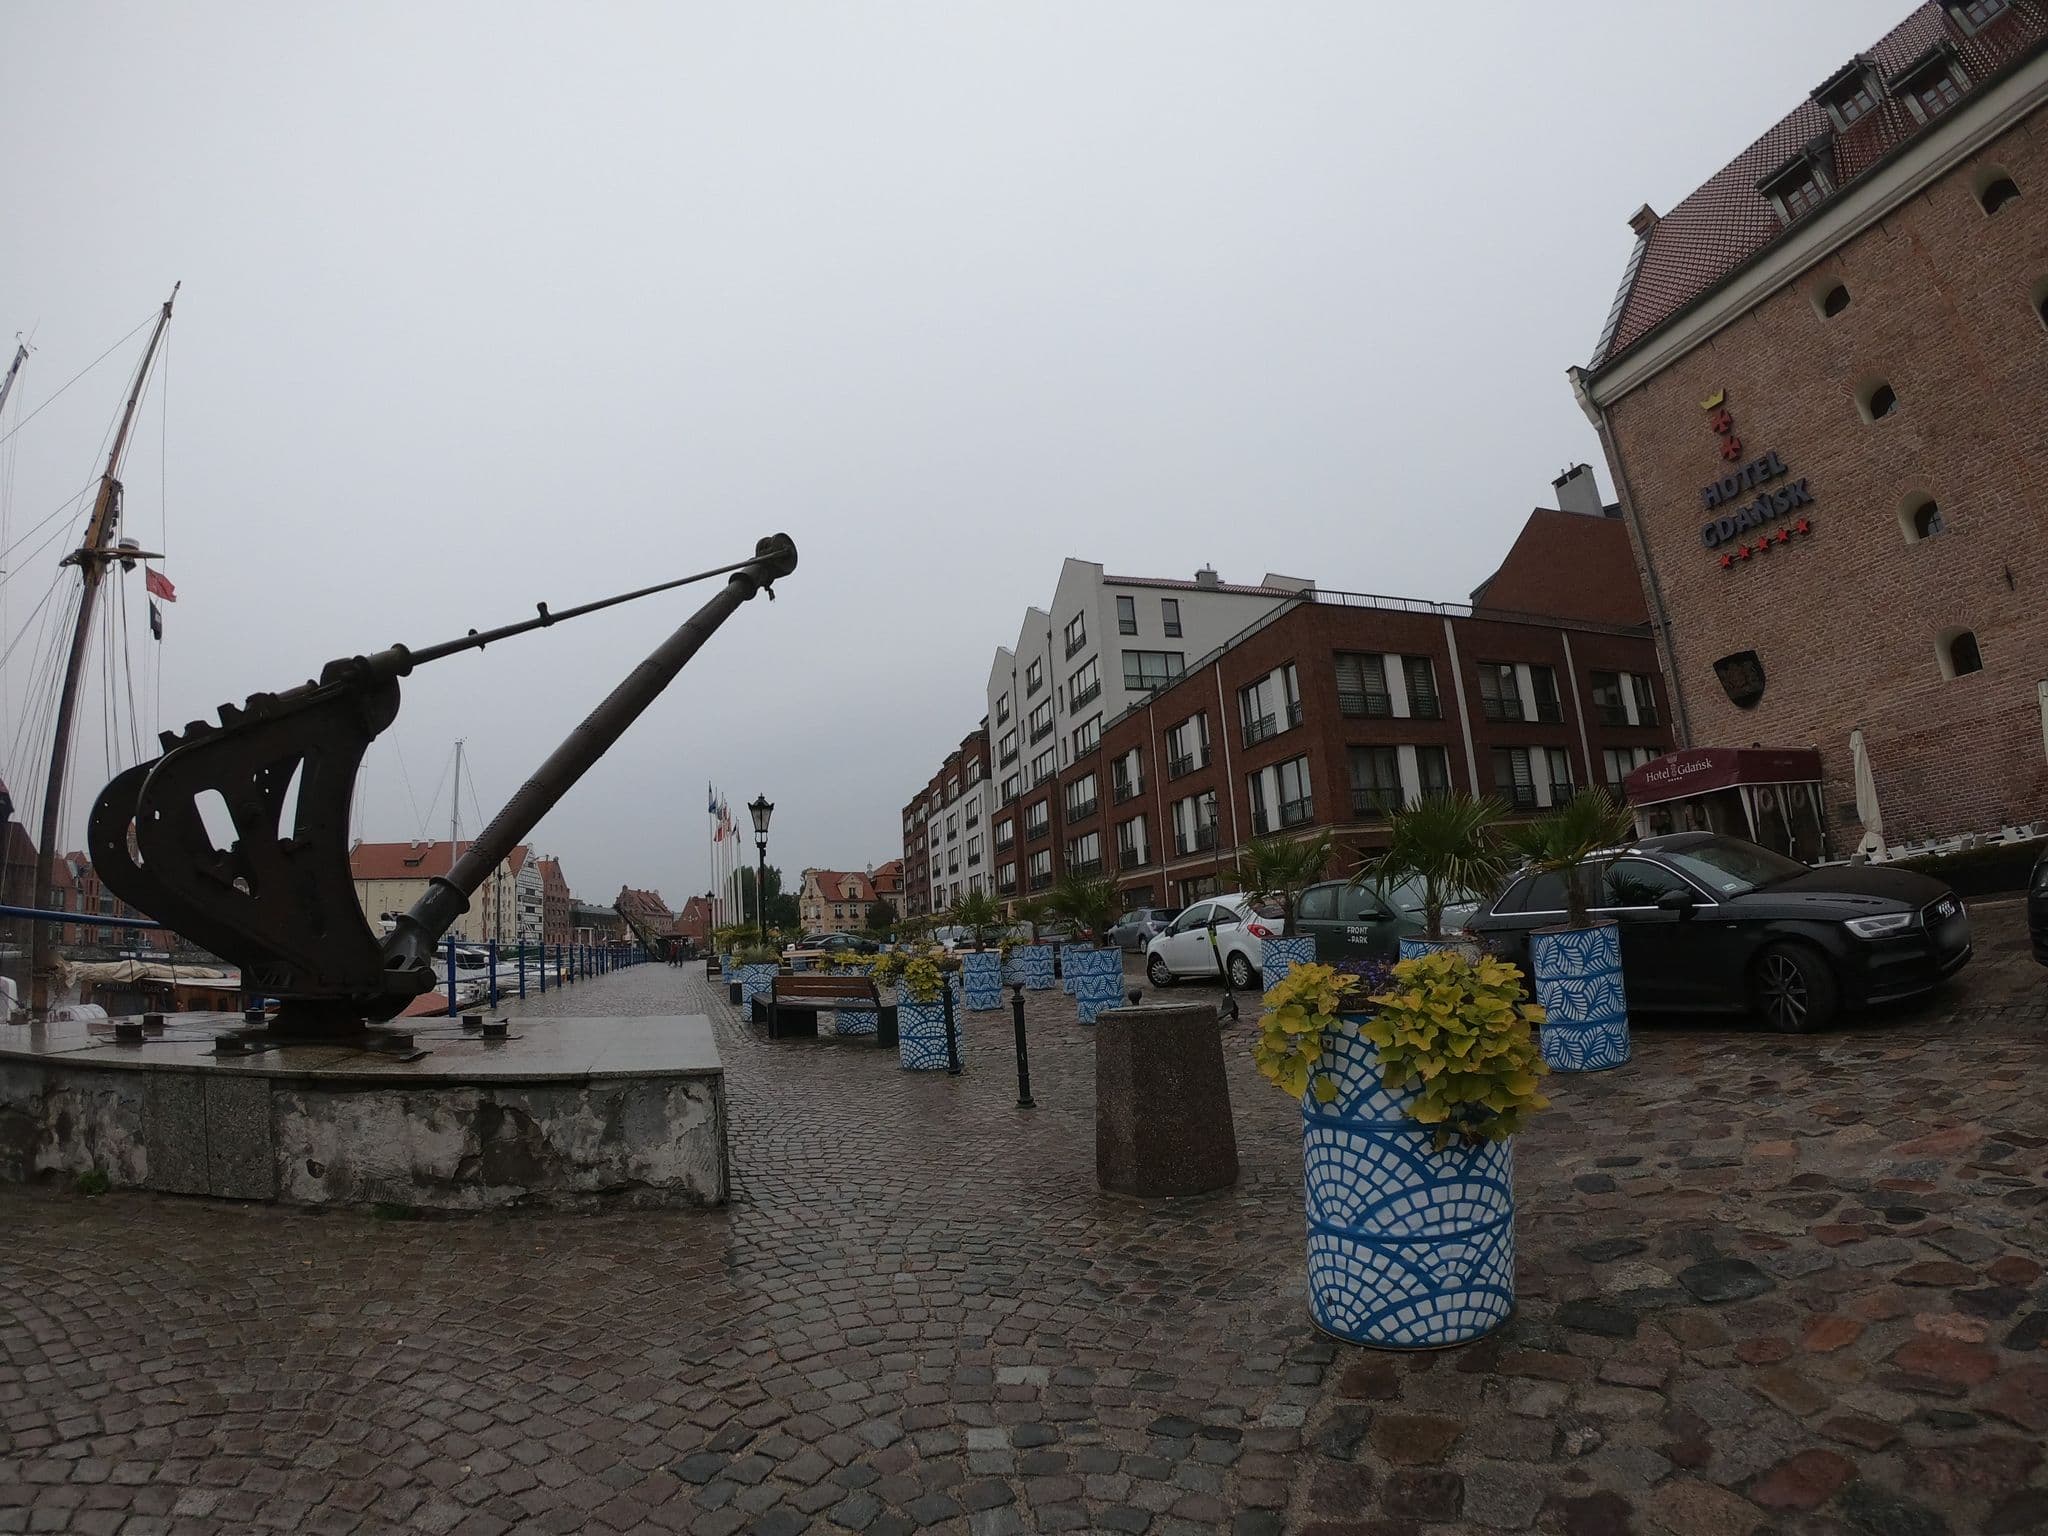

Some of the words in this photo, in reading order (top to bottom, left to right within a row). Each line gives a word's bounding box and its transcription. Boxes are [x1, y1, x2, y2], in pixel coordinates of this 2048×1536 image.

[1701, 450, 1788, 510] HOTEL
[1701, 477, 1814, 548] GDAŃSK
[1646, 767, 1670, 783] Hotel
[1677, 757, 1713, 775] Gdańsk
[1346, 926, 1369, 934] FRONT
